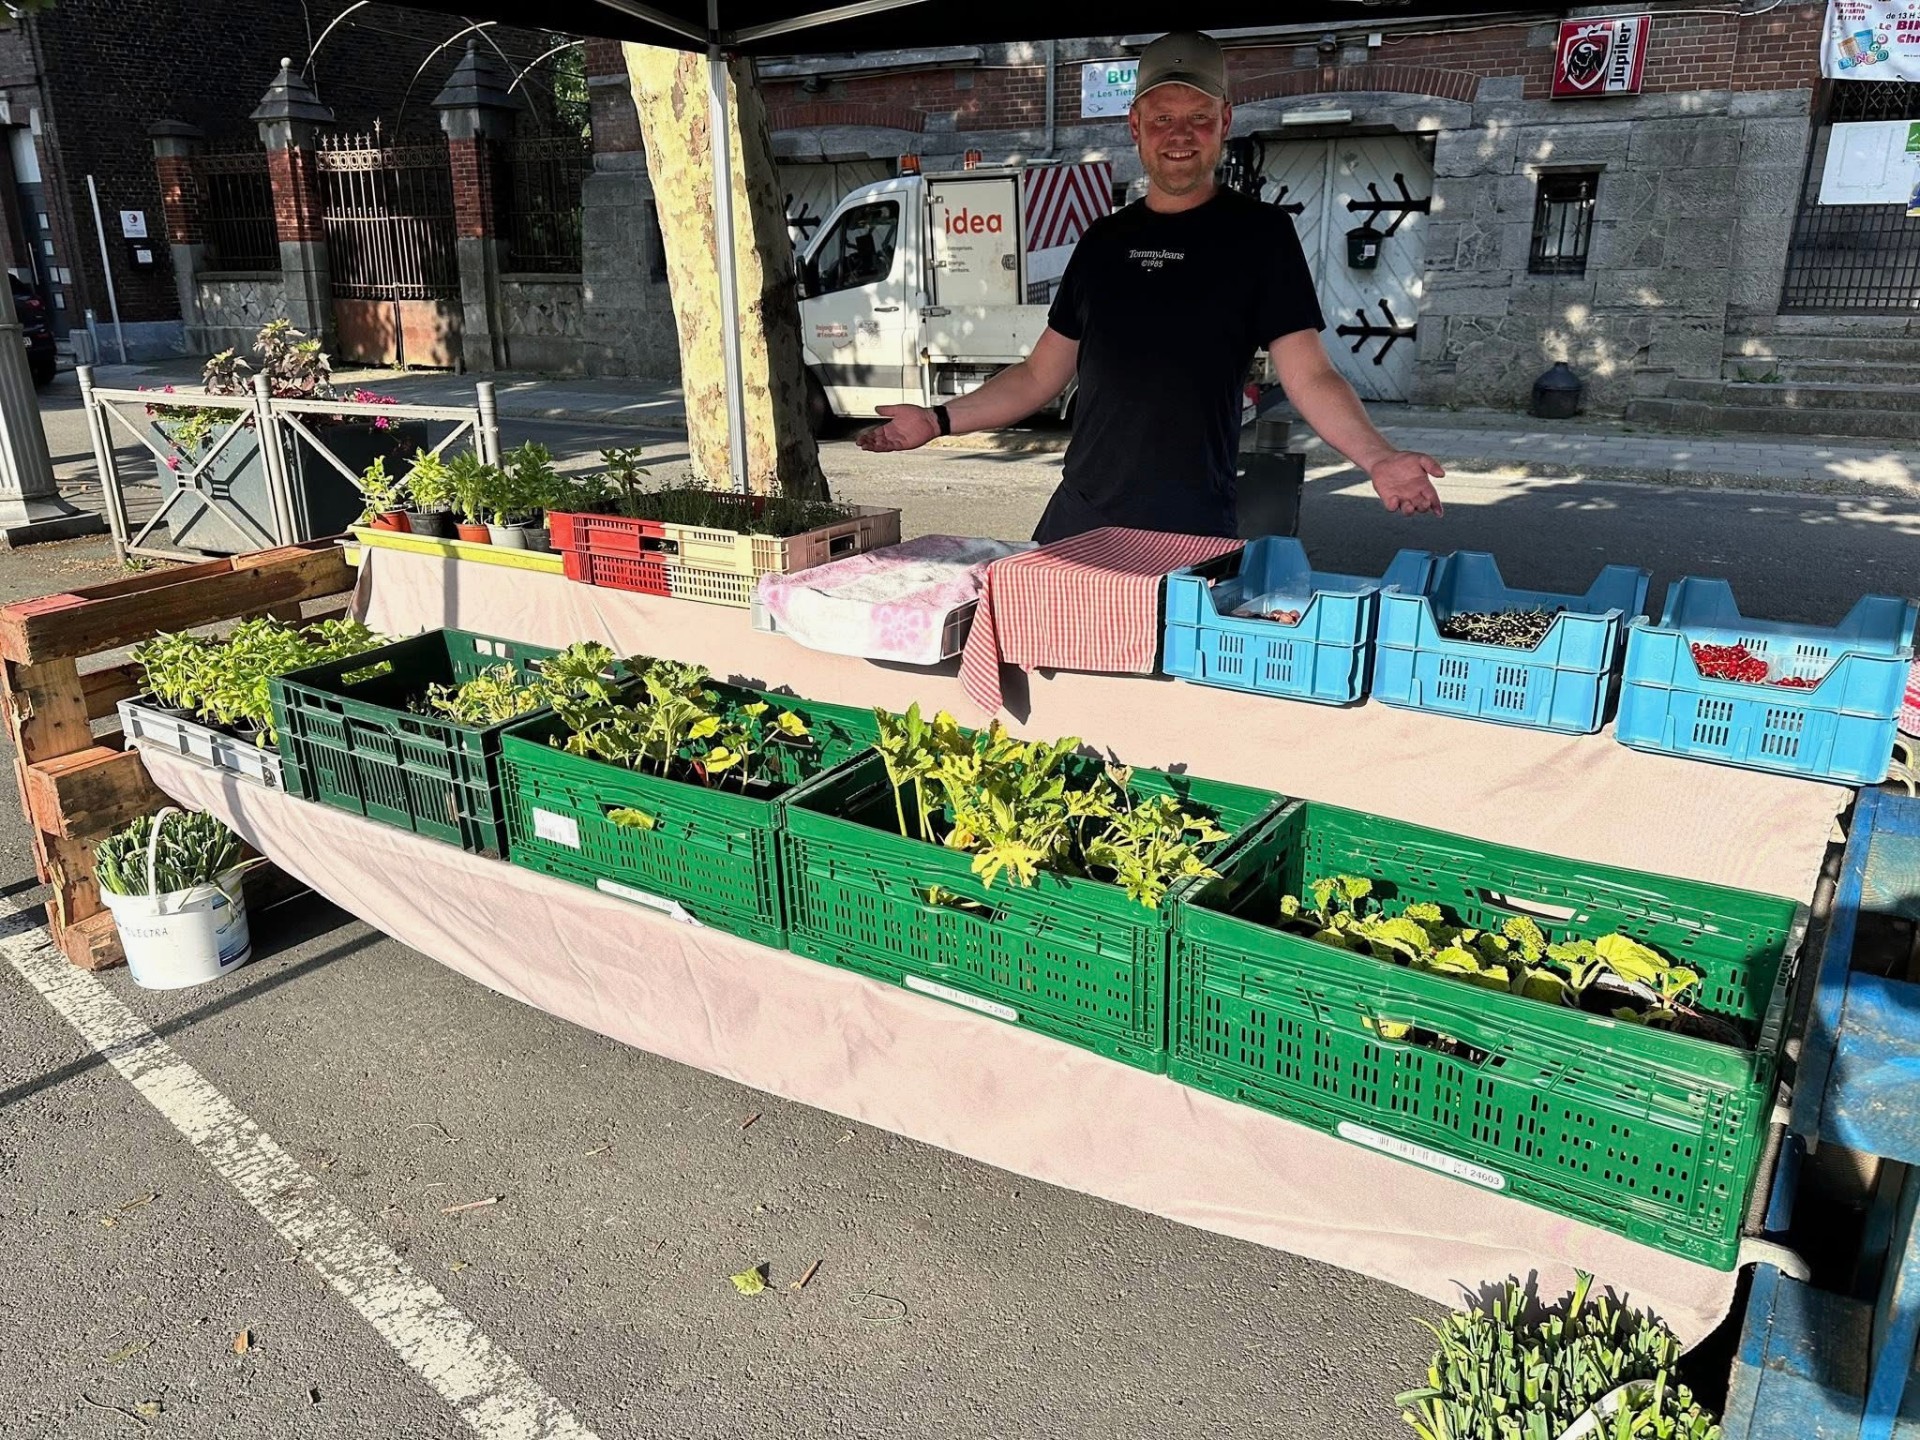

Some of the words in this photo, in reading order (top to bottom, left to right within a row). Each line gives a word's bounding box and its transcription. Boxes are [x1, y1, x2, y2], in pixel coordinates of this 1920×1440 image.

[1886, 12, 1896, 20] de
[1898, 12, 1907, 20] 13
[1879, 22, 1892, 31] Le
[1609, 22, 1632, 88] Jupiler
[1097, 90, 1112, 98] Les
[945, 207, 1002, 235] idea
[1470, 1169, 1500, 1185] 24603
